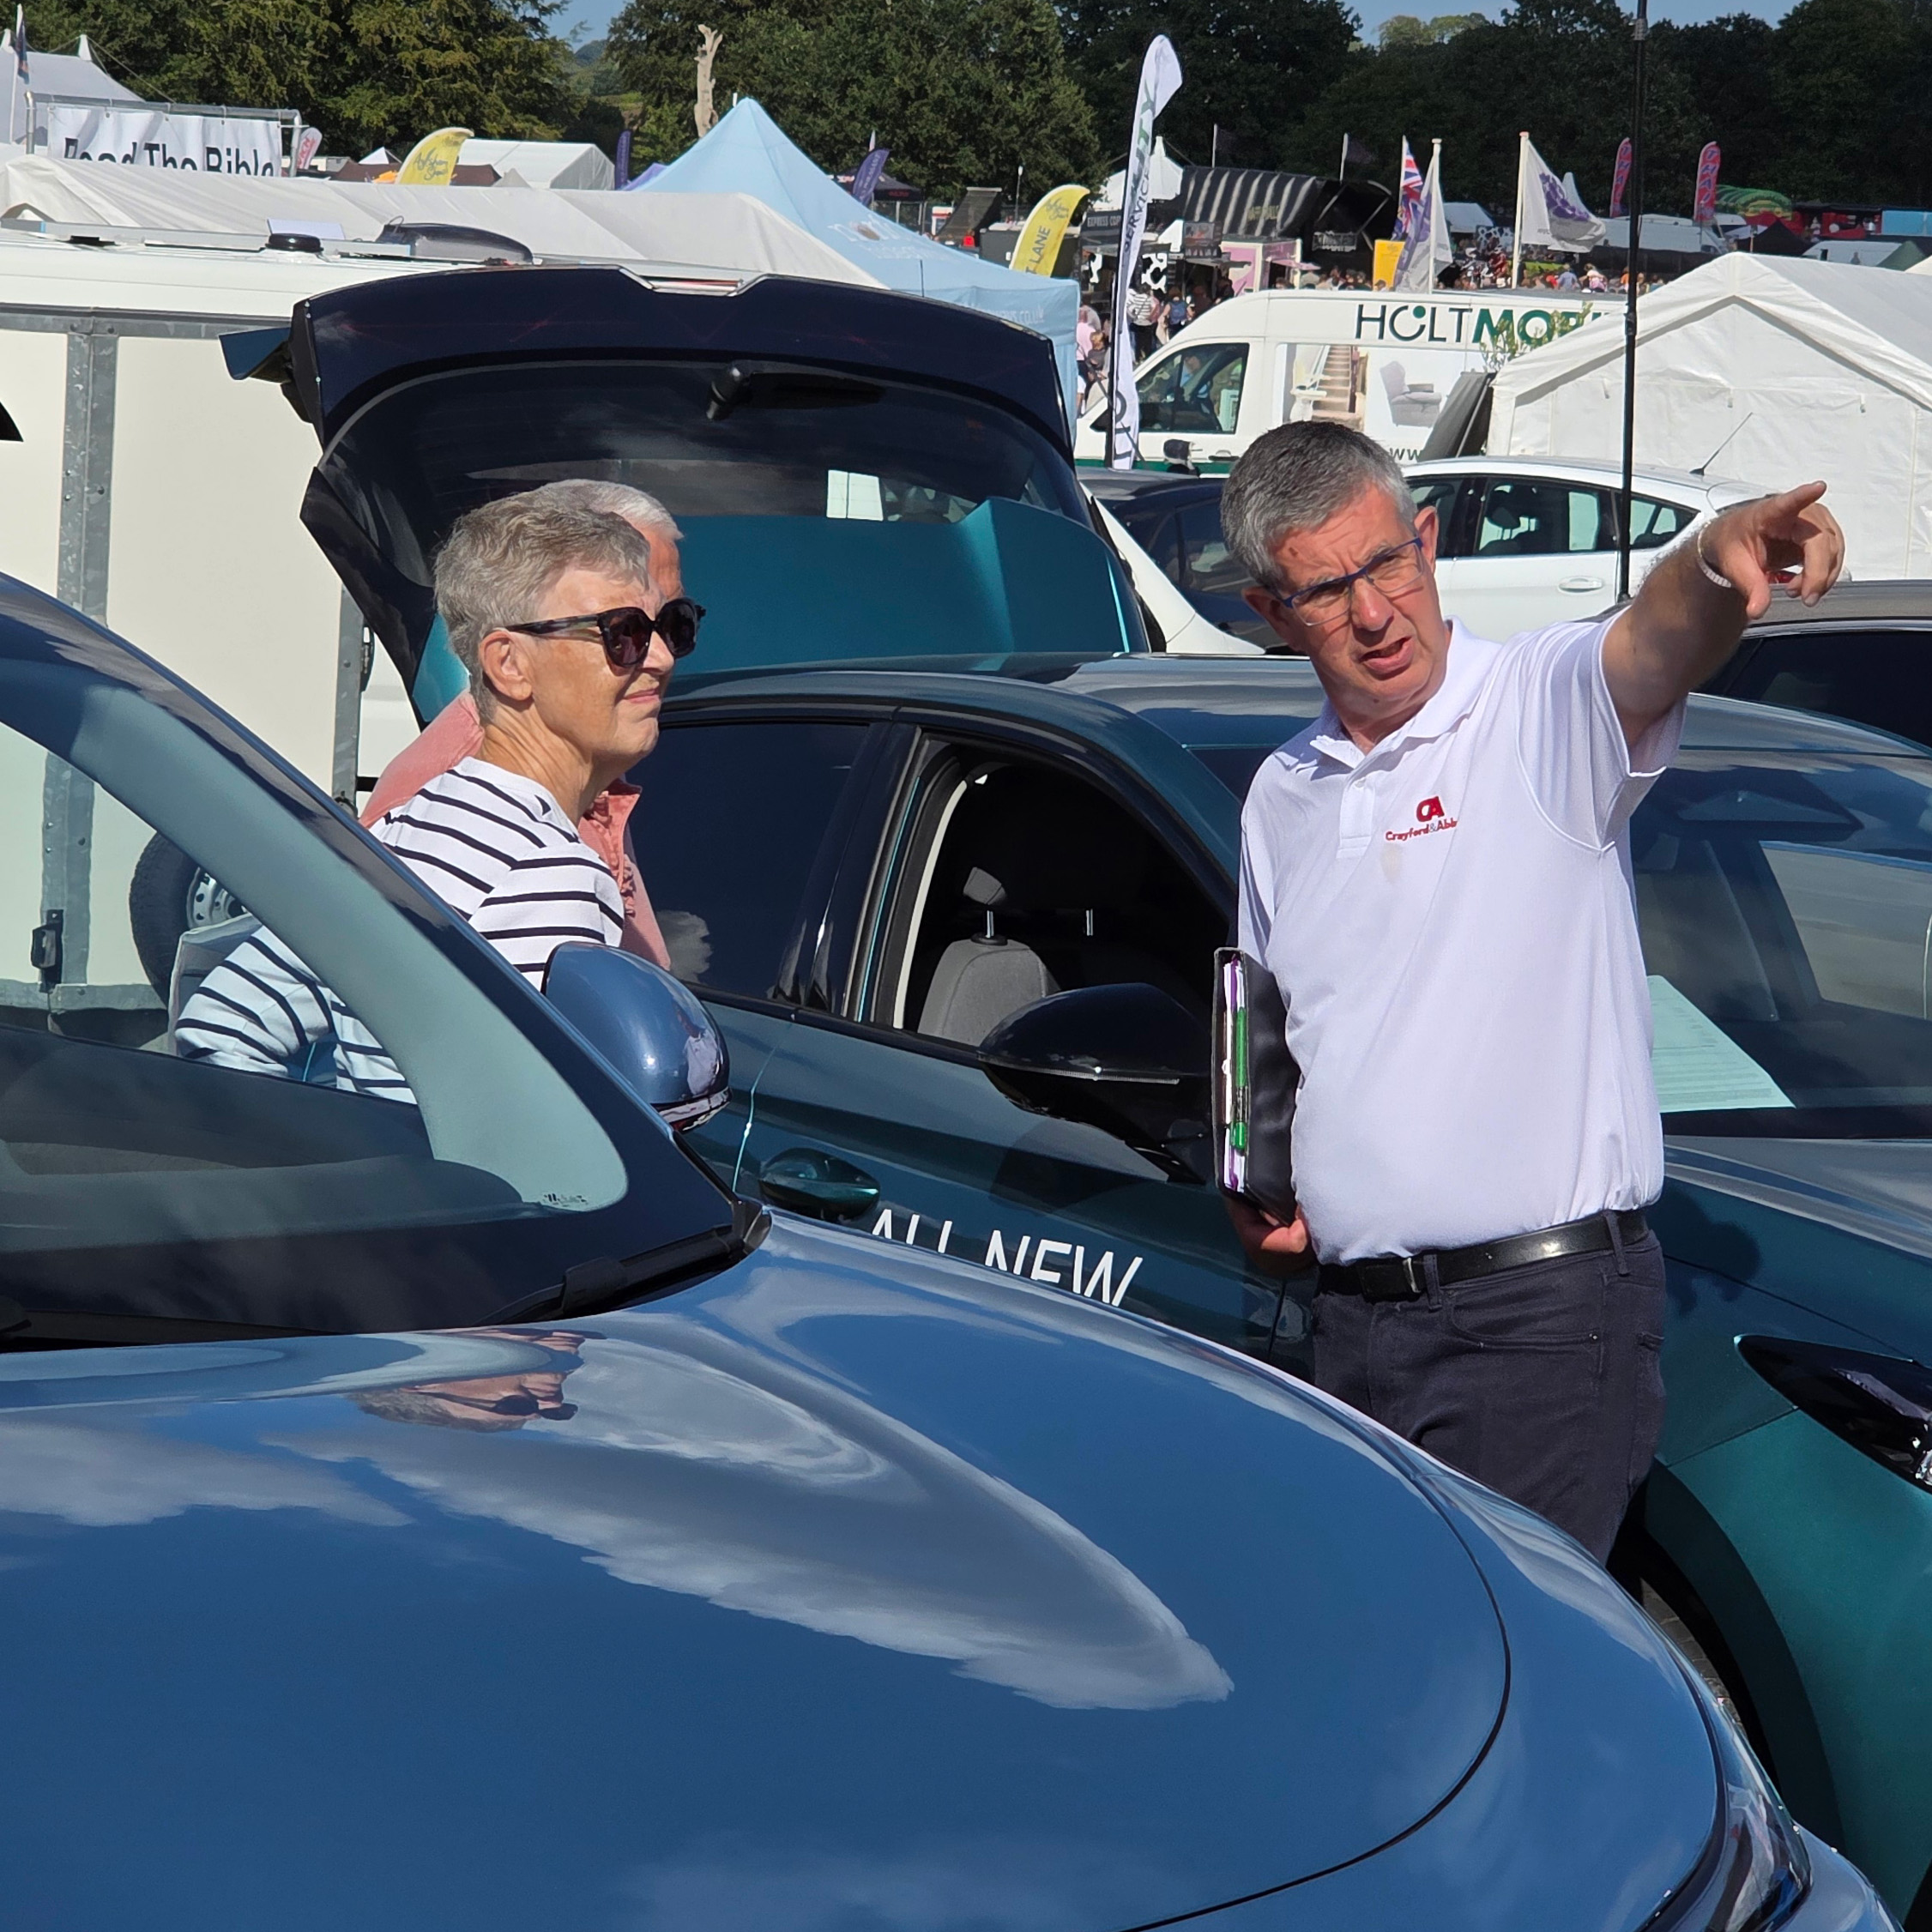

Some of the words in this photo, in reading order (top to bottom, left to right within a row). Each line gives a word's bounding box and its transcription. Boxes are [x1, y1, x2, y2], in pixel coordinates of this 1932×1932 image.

[1699, 148, 1717, 202] THAI
[1031, 226, 1051, 265] LANE
[985, 1229, 1144, 1307] NEW
